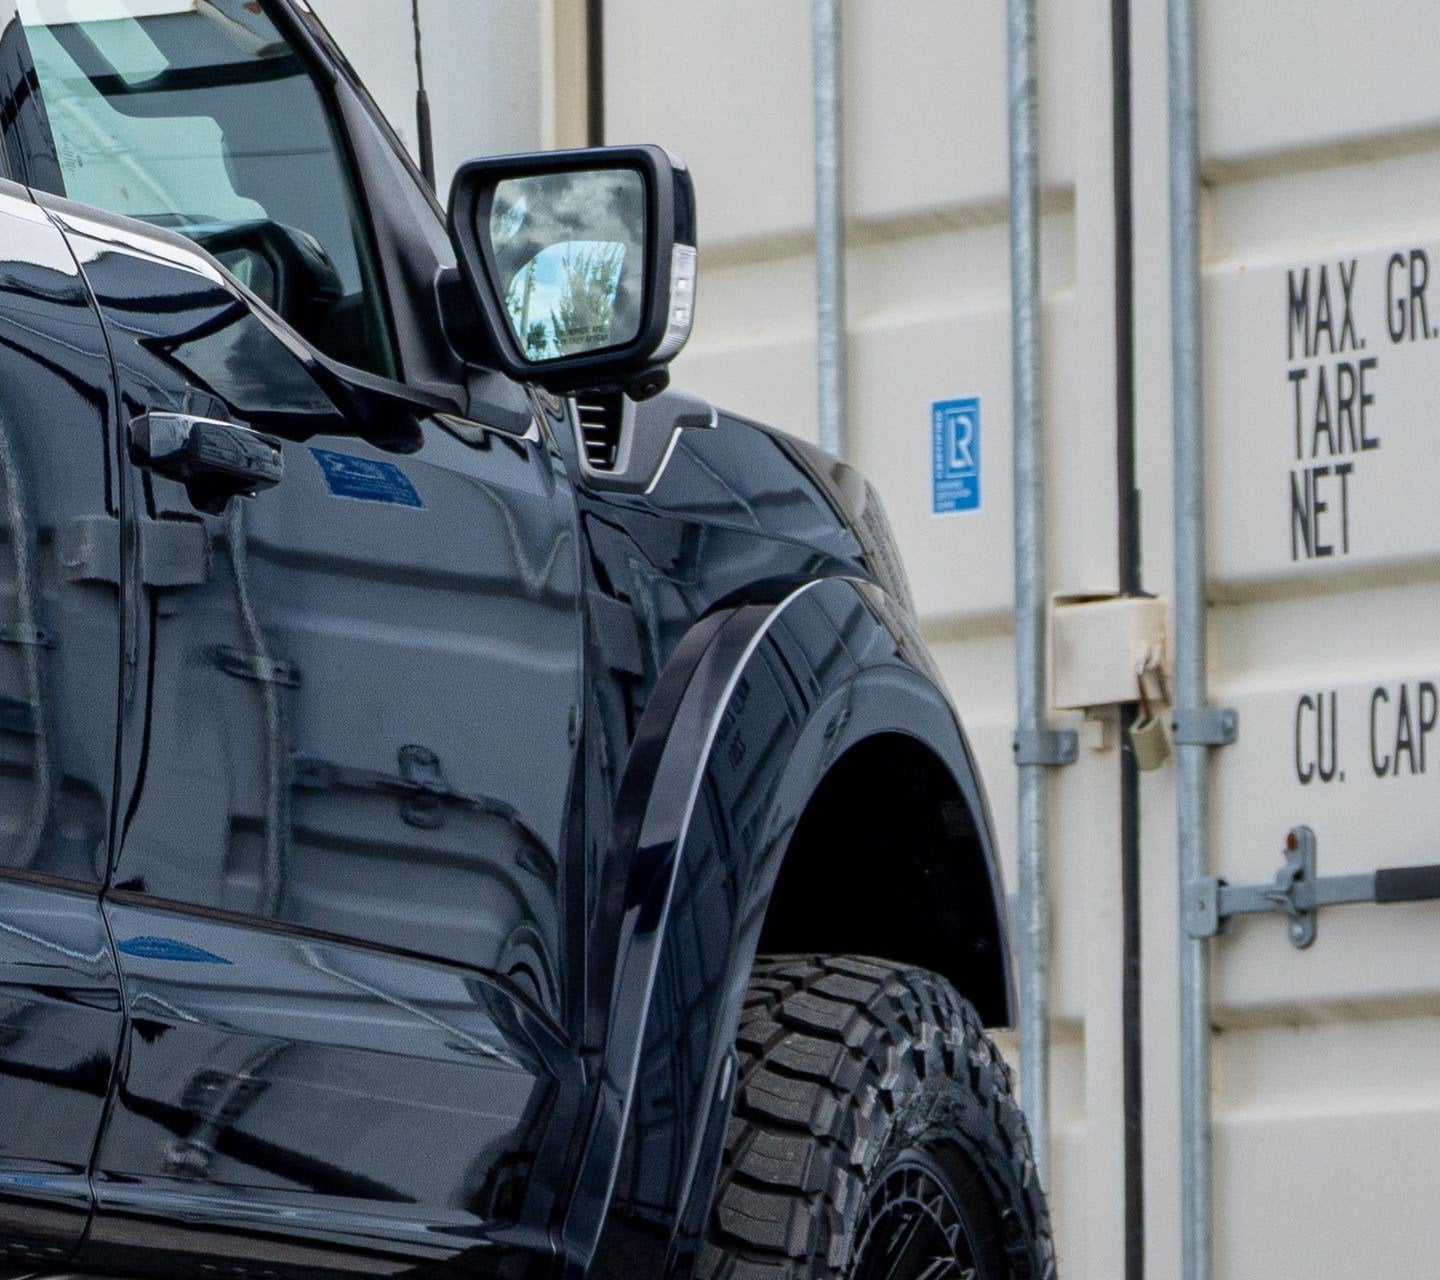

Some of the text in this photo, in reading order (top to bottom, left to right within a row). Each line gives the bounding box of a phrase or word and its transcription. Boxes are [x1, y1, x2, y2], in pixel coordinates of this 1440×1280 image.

[1287, 249, 1439, 360] MAX. GR.
[1288, 357, 1380, 460] TARE
[1290, 463, 1353, 560] NET
[1296, 692, 1345, 785] CU.
